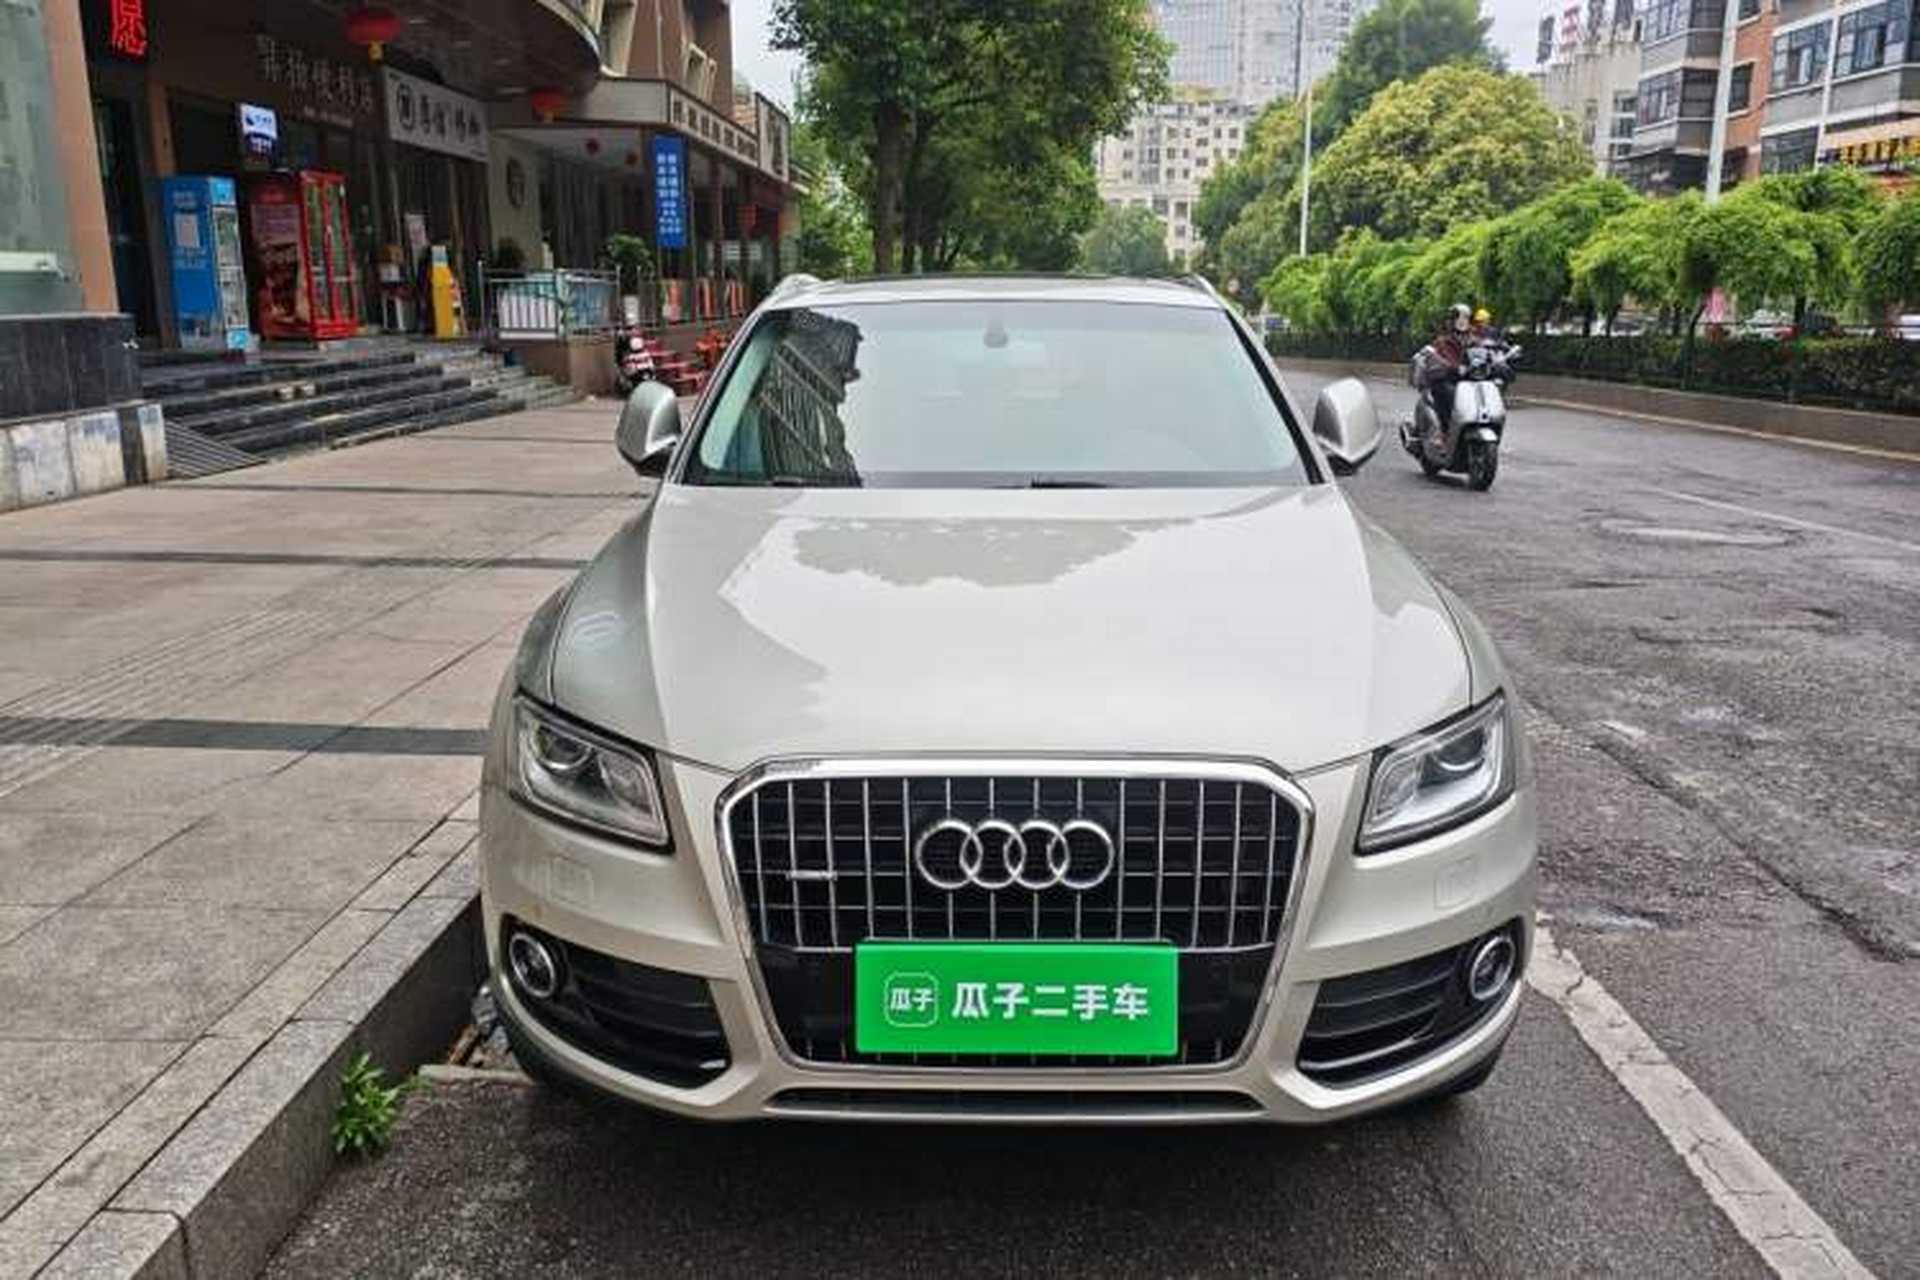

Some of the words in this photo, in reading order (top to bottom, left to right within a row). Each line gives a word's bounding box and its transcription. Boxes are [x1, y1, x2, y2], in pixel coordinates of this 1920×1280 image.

[889, 987, 935, 1012] 瓜子
[951, 981, 1149, 1021] 瓜子二手车
